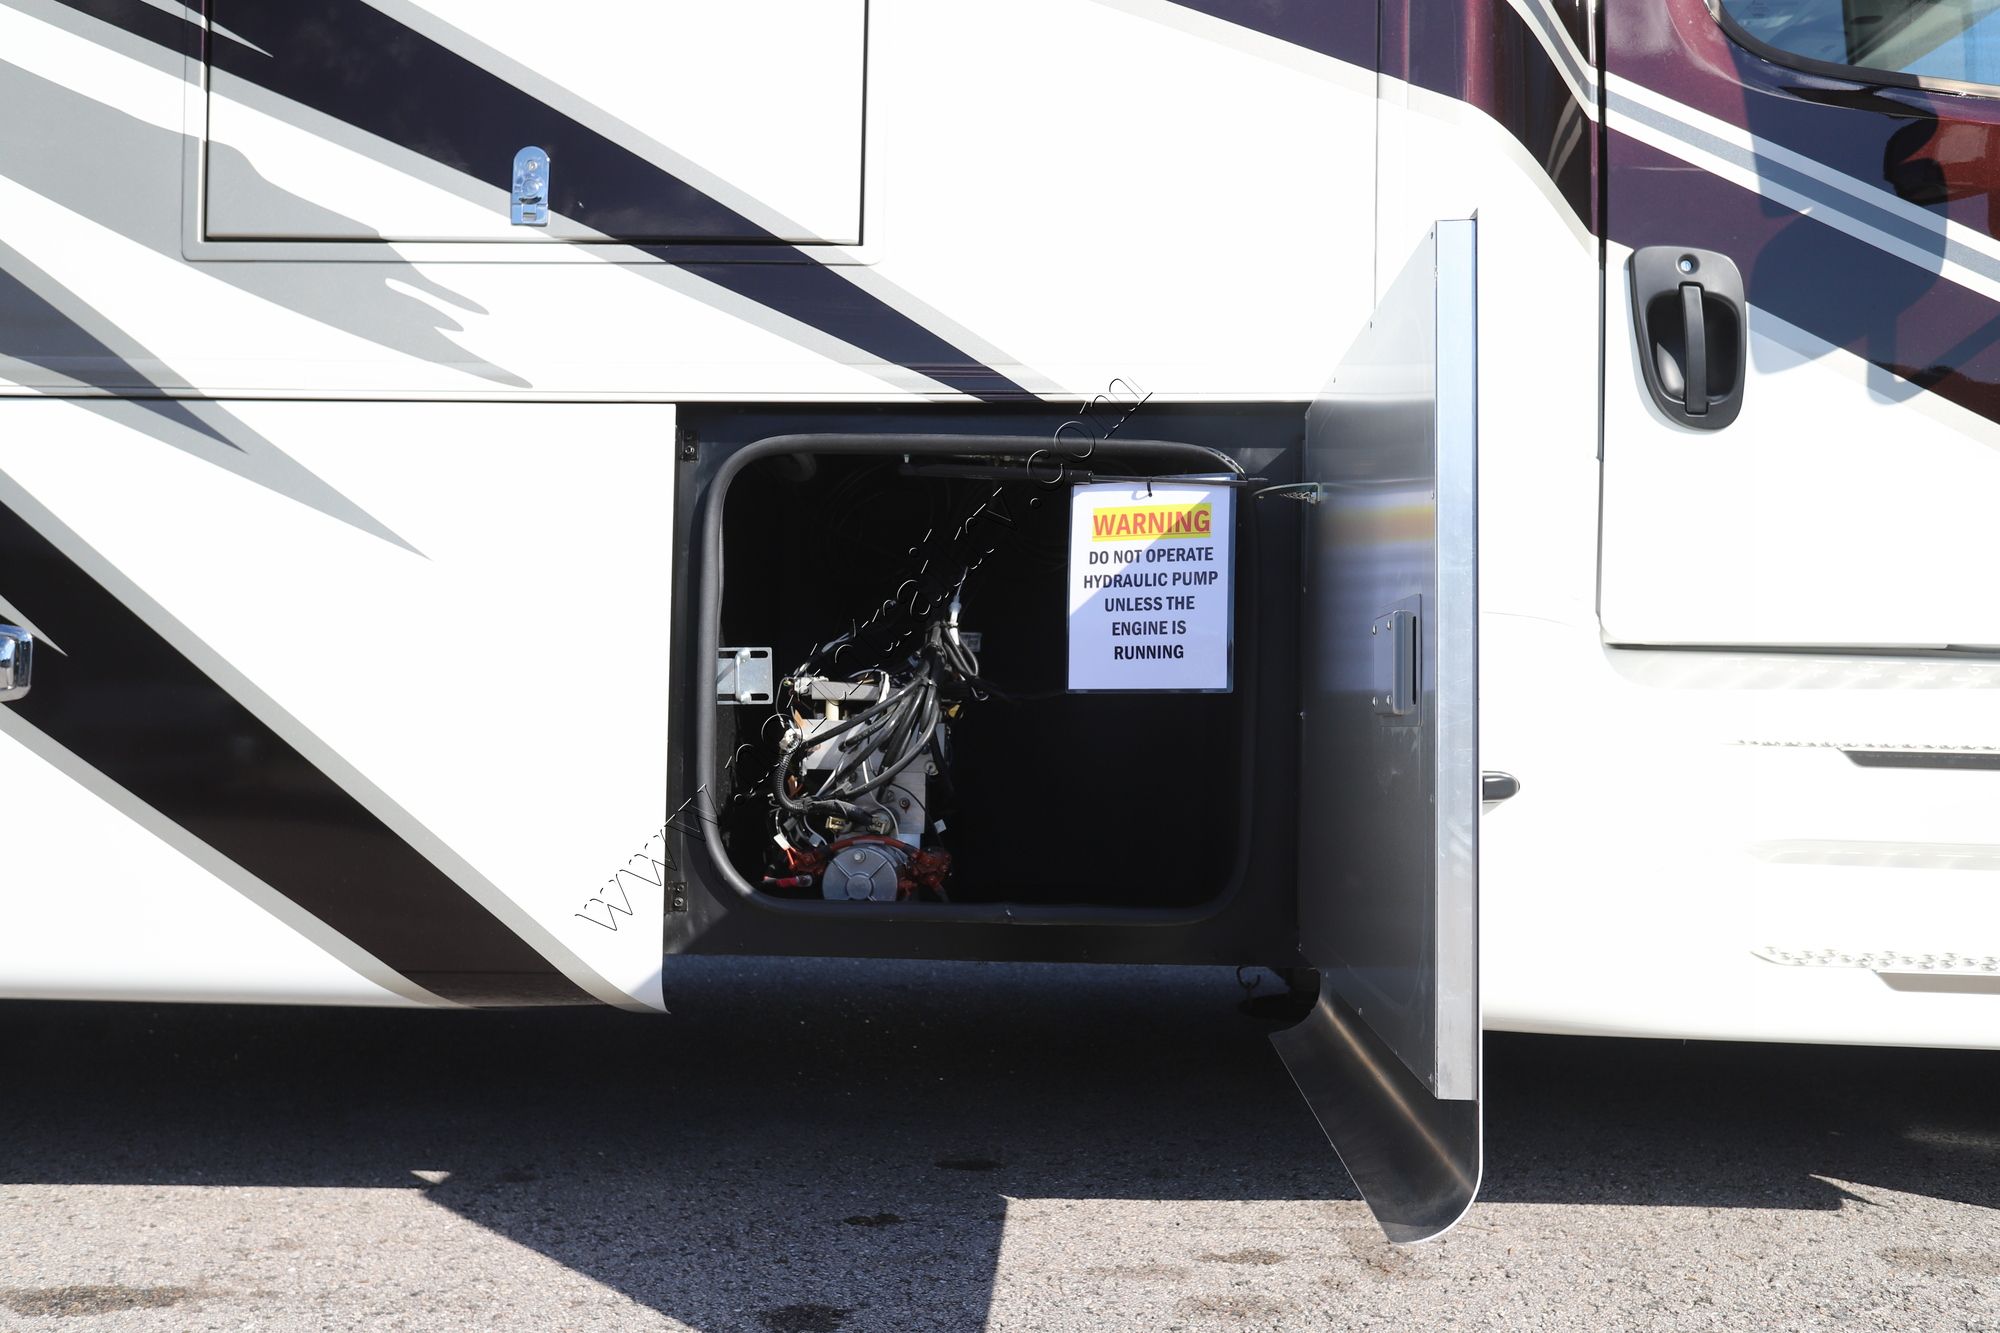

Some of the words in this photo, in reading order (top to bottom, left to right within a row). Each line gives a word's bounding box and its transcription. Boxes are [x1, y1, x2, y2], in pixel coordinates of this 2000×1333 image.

[1093, 510, 1210, 536] WARNING
[1089, 550, 1109, 564] DO
[1113, 549, 1142, 564] NOT
[1146, 547, 1214, 563] OPERATE
[1084, 573, 1168, 589] HYDRAULIC
[1172, 571, 1218, 586] PUMP
[1104, 597, 1163, 612] UNLESS
[1166, 596, 1195, 610] THE
[1112, 621, 1168, 636] ENGINE
[1172, 620, 1187, 634] IS
[1114, 644, 1184, 660] RUNNING
